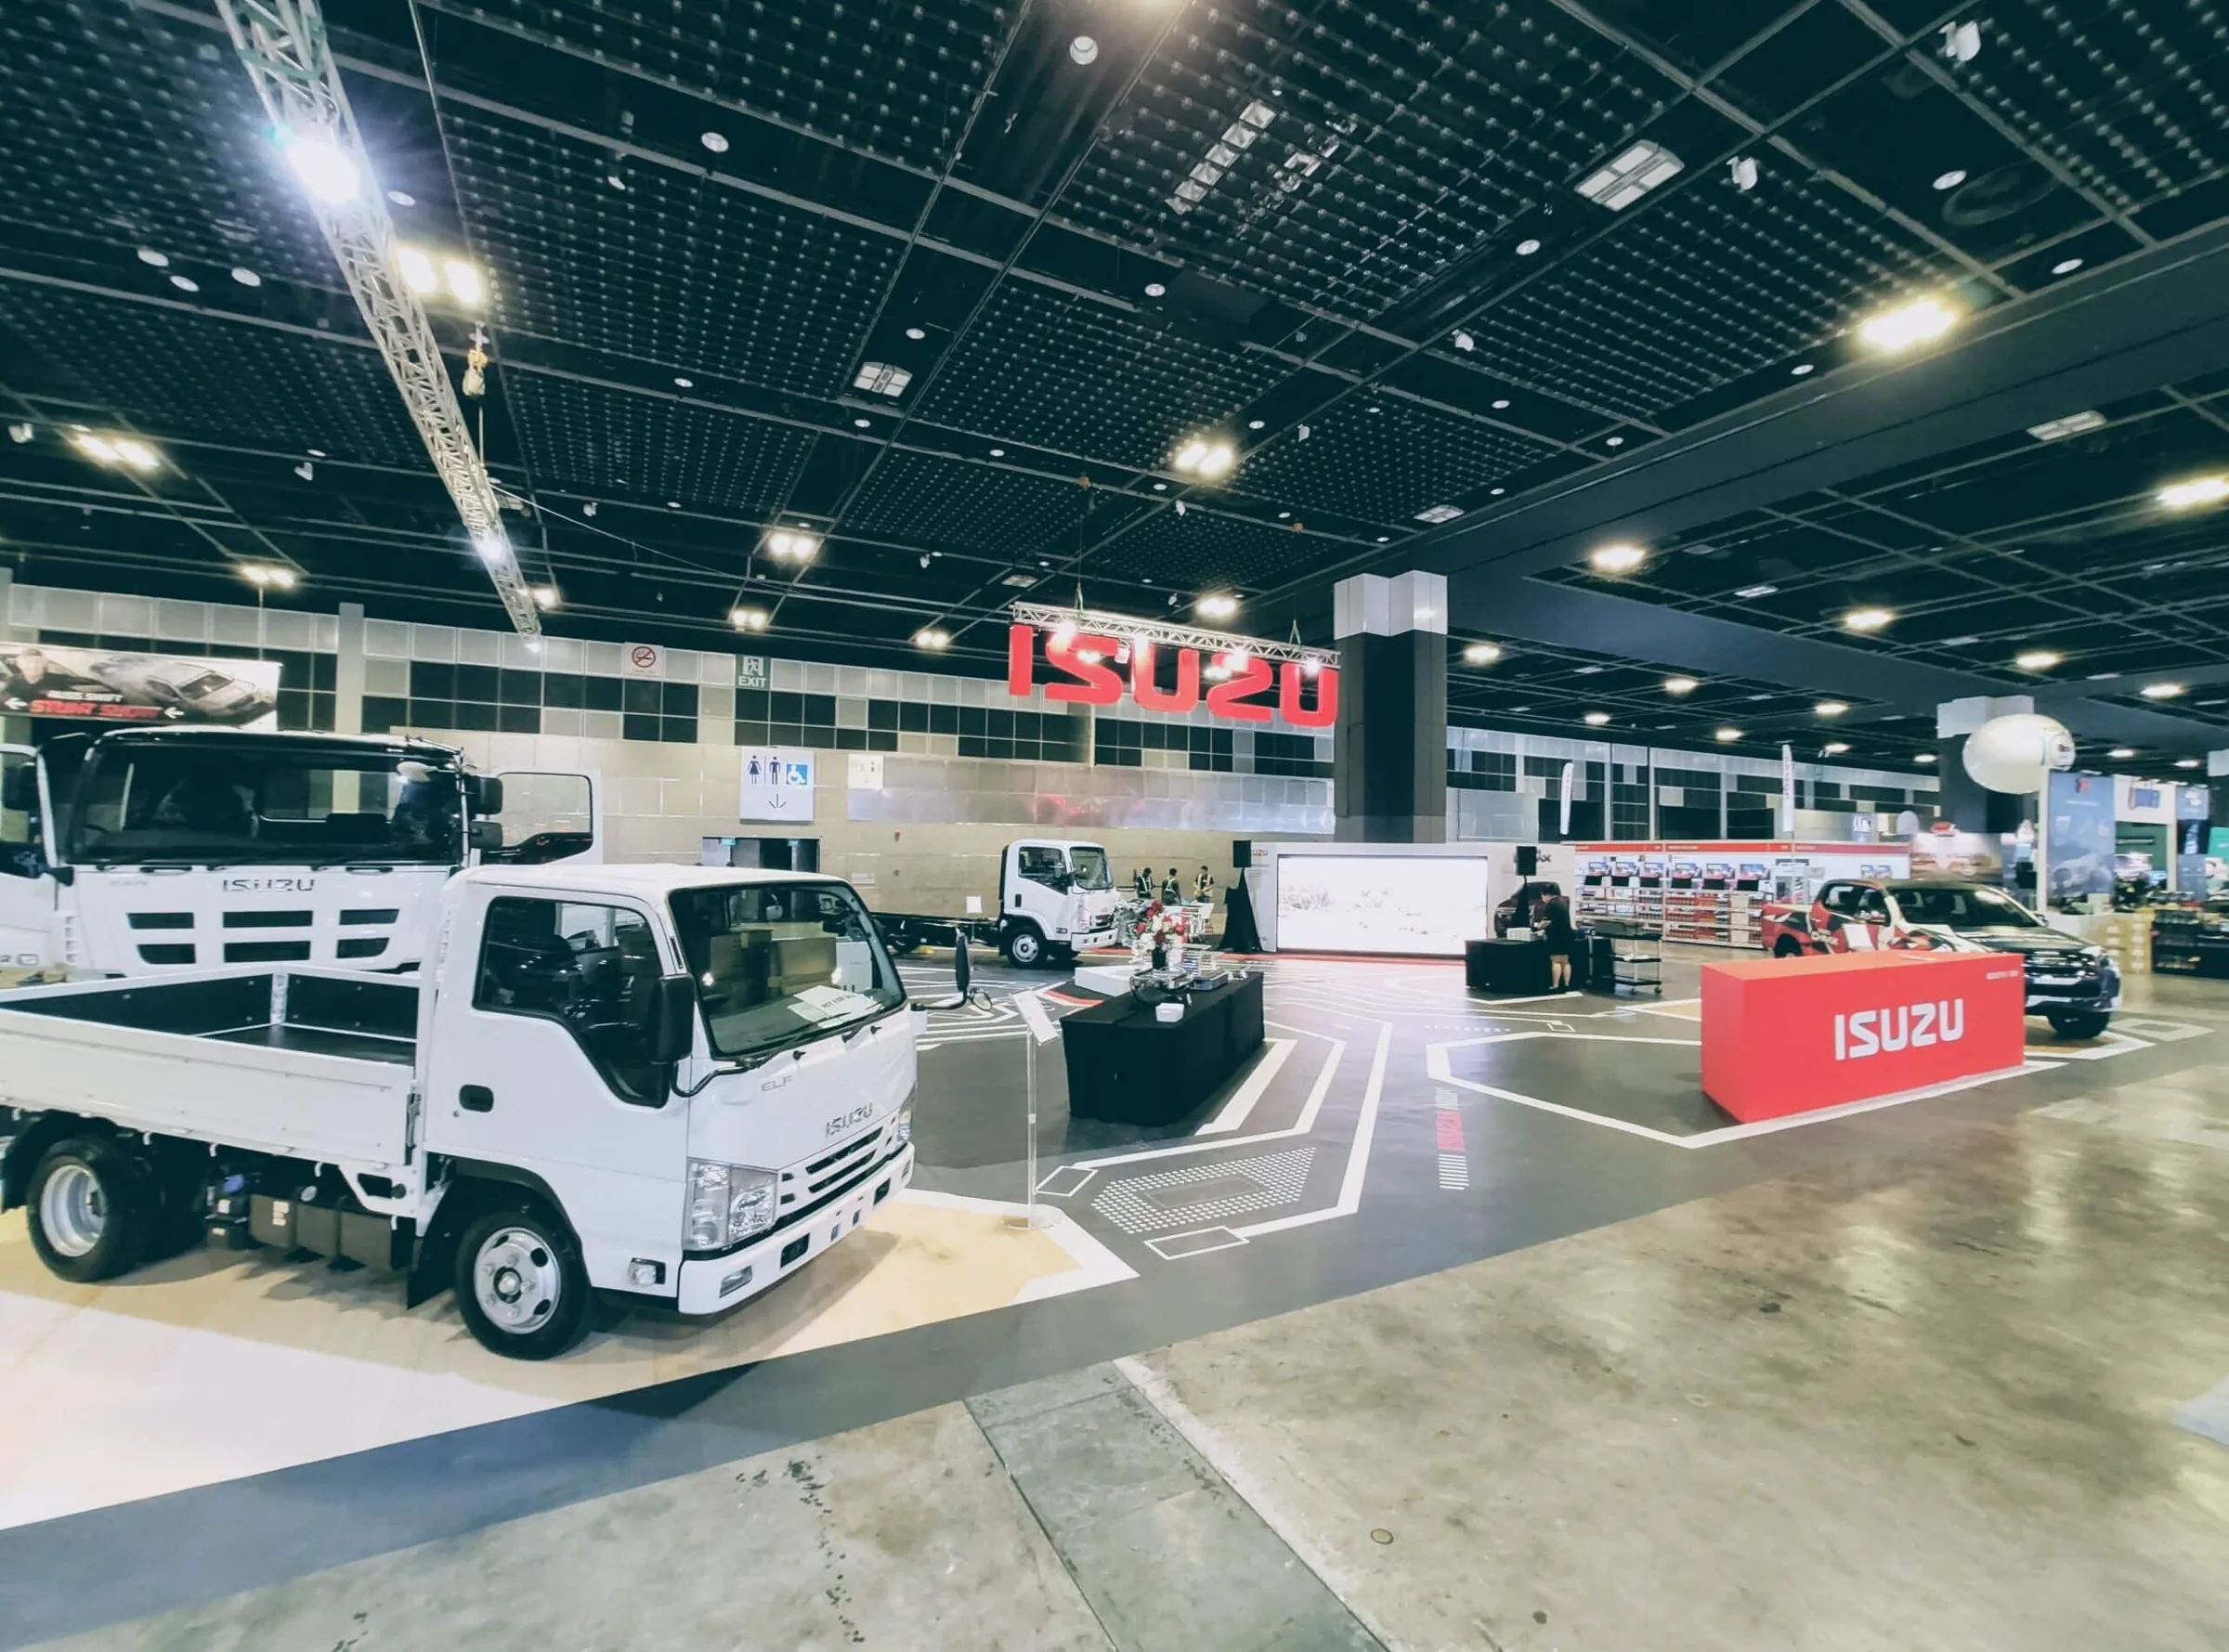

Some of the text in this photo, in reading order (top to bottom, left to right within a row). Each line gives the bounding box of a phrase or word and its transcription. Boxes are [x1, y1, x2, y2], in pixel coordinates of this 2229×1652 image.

[737, 676, 767, 689] EXIT
[1009, 624, 1339, 728] ISUZU
[222, 878, 316, 891] ISUZU
[1834, 998, 1964, 1061] ISUZU
[761, 1075, 793, 1092] ELF
[825, 1101, 874, 1138] ISUZU
